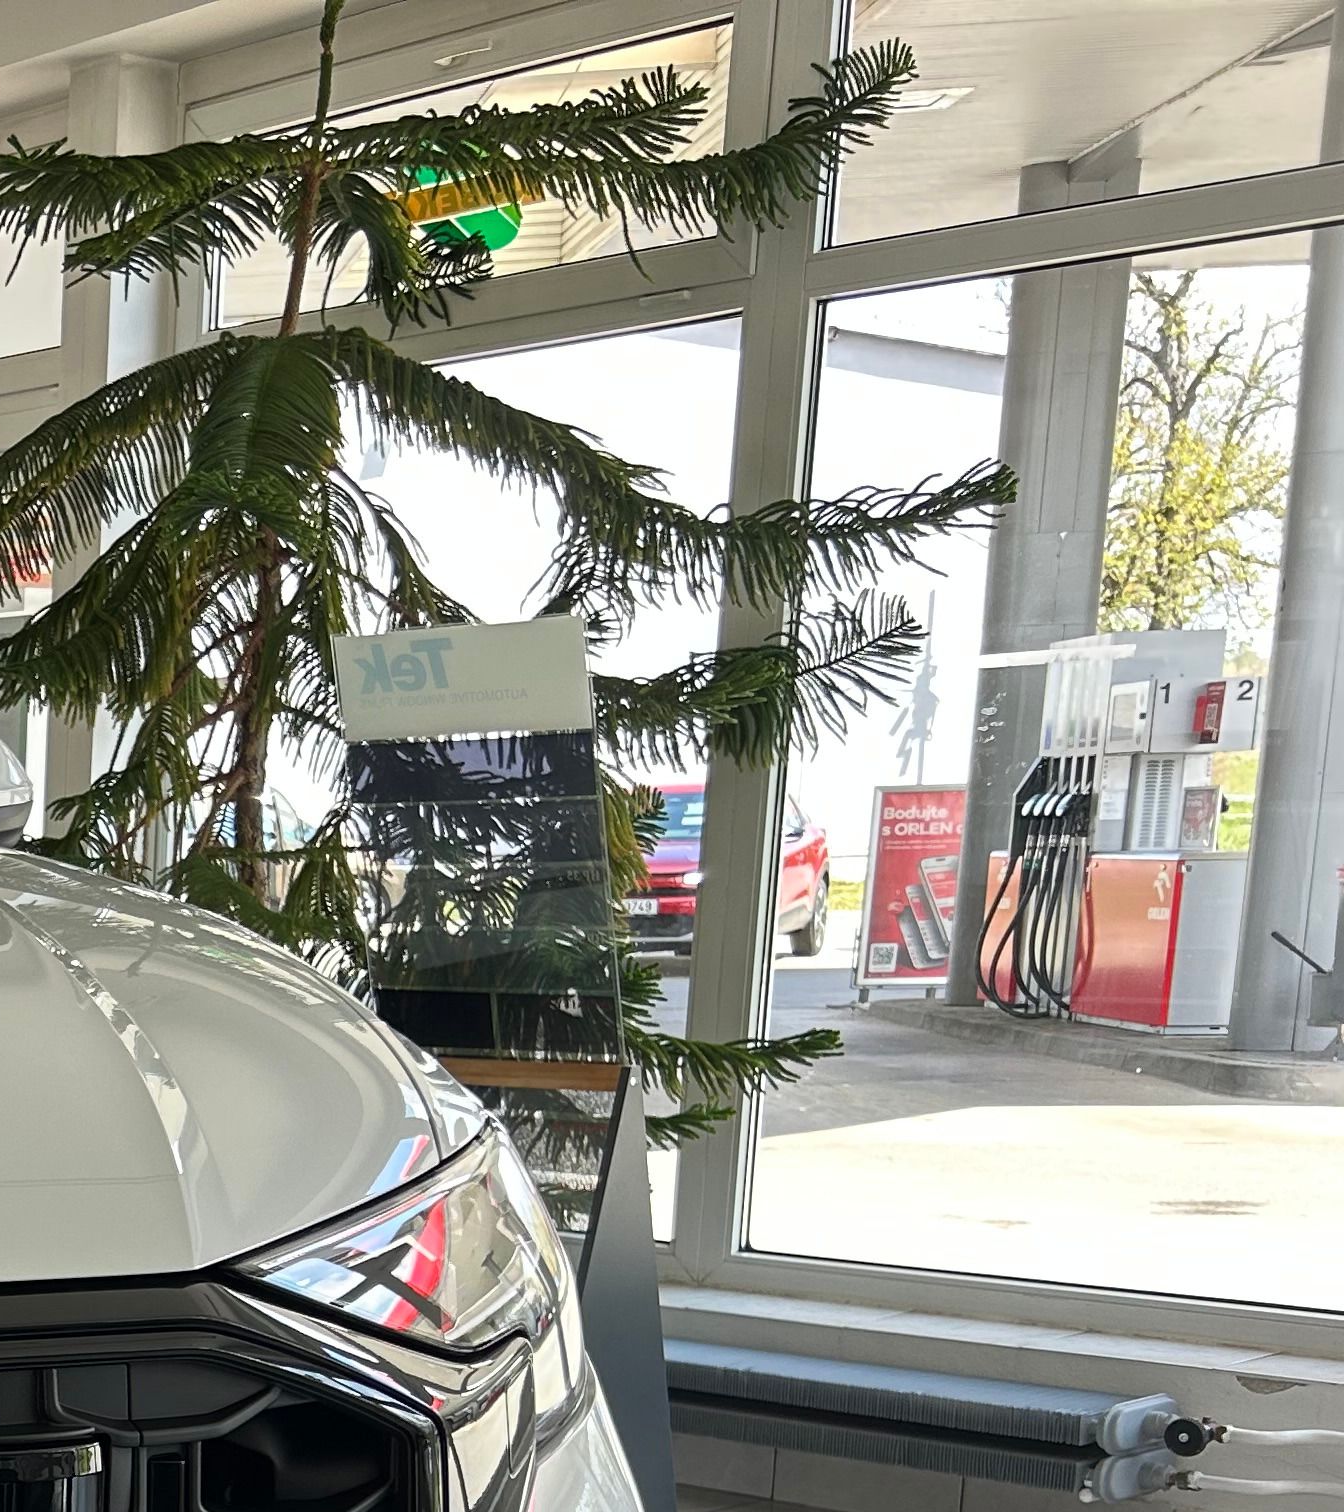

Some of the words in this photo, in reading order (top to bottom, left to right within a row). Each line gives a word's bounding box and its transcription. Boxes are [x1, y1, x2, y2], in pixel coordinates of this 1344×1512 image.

[1159, 682, 1171, 704] 1
[1237, 680, 1254, 701] 2
[883, 805, 949, 821] Bodujte
[881, 826, 891, 836] s
[894, 822, 954, 836] ORLEN
